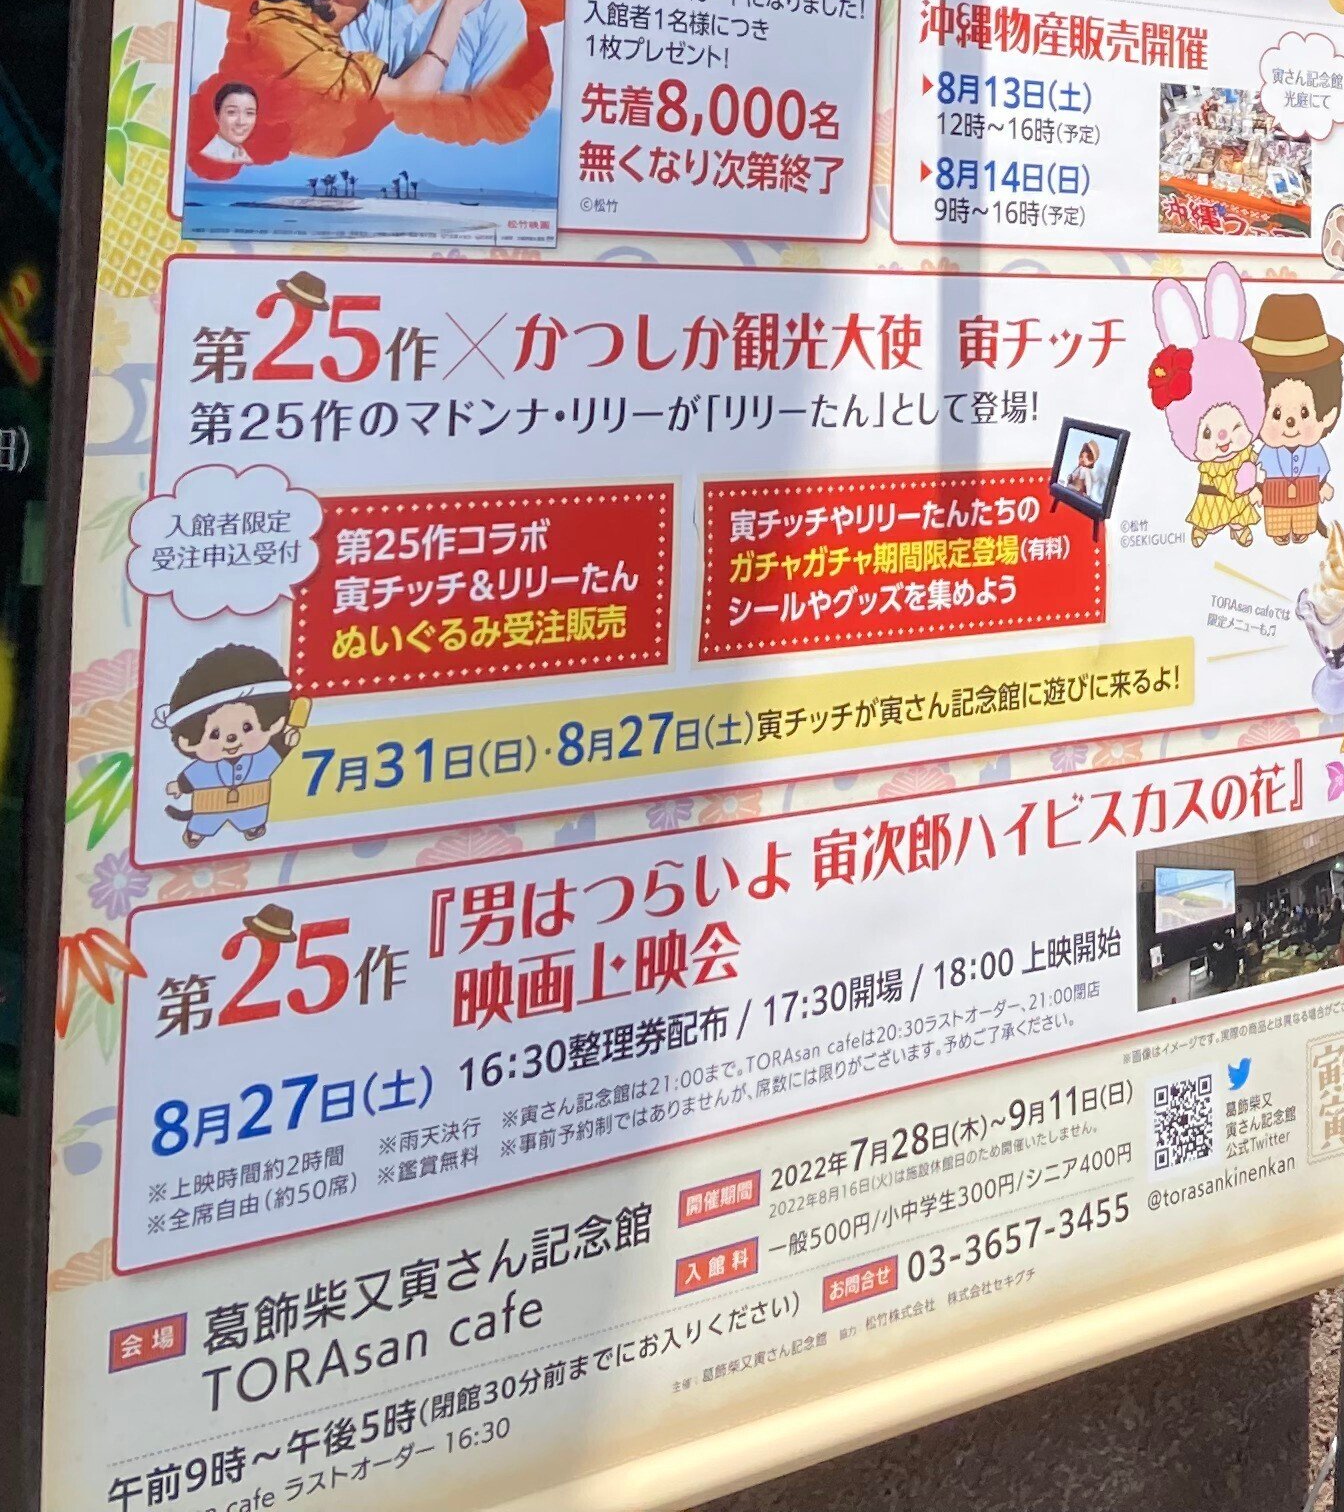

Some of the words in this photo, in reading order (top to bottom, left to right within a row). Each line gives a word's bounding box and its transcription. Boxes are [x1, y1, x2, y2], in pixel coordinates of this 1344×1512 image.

[583, 0, 770, 41] 入館者1名様につき
[586, 34, 730, 69] 1枚プレゼント!
[580, 78, 840, 141] 先着8,000名
[936, 70, 1093, 115] 8月13日(土)
[579, 140, 844, 195] 無くなり次第終了
[936, 156, 1091, 196] 8月14日(日)
[958, 313, 1128, 371] 寅チッチ
[164, 509, 292, 538] 入館者限定
[336, 517, 551, 566] 第25作コラボ
[730, 496, 1040, 543] 寅チッチやリリーたんたちの
[151, 539, 302, 571] 受注申込受付
[332, 559, 640, 615] 寅チッチ&リリーたん
[728, 576, 1018, 628] シールやグッズを集めよう
[331, 603, 628, 660] ぬいぐるみ受注販売
[428, 840, 792, 959] 『男はつらいよ
[812, 758, 1304, 890] 寅次郎ハイビスカスの花』
[155, 919, 409, 1039] 第25作
[451, 919, 742, 1032] 映画上映会
[151, 1065, 434, 1157] 8月27日(土)
[459, 1004, 729, 1093] 16:30整理券配布
[763, 969, 903, 1026] 17:30開場
[934, 950, 1014, 990] 18:00
[1021, 927, 1122, 976] 上映開始
[1225, 1091, 1273, 1116] 葛飾柴又
[1225, 1105, 1297, 1140] 寅さん記念館
[1225, 1131, 1291, 1160] 公式Twitter
[685, 1179, 754, 1218] 開催期間
[1147, 1154, 1296, 1212] @torasankinenkan
[907, 1191, 1130, 1282] 03-3657-3455
[202, 1201, 653, 1357] 葛飾柴又寅さん記念館
[684, 1248, 749, 1286] 入館料
[828, 1265, 891, 1301] お問合せ
[119, 1326, 175, 1358] 会場
[202, 1331, 428, 1412] TORAsan
[449, 1291, 544, 1347] cafe
[283, 1444, 436, 1501] ラストオーダー
[445, 1416, 511, 1454] 16:30
